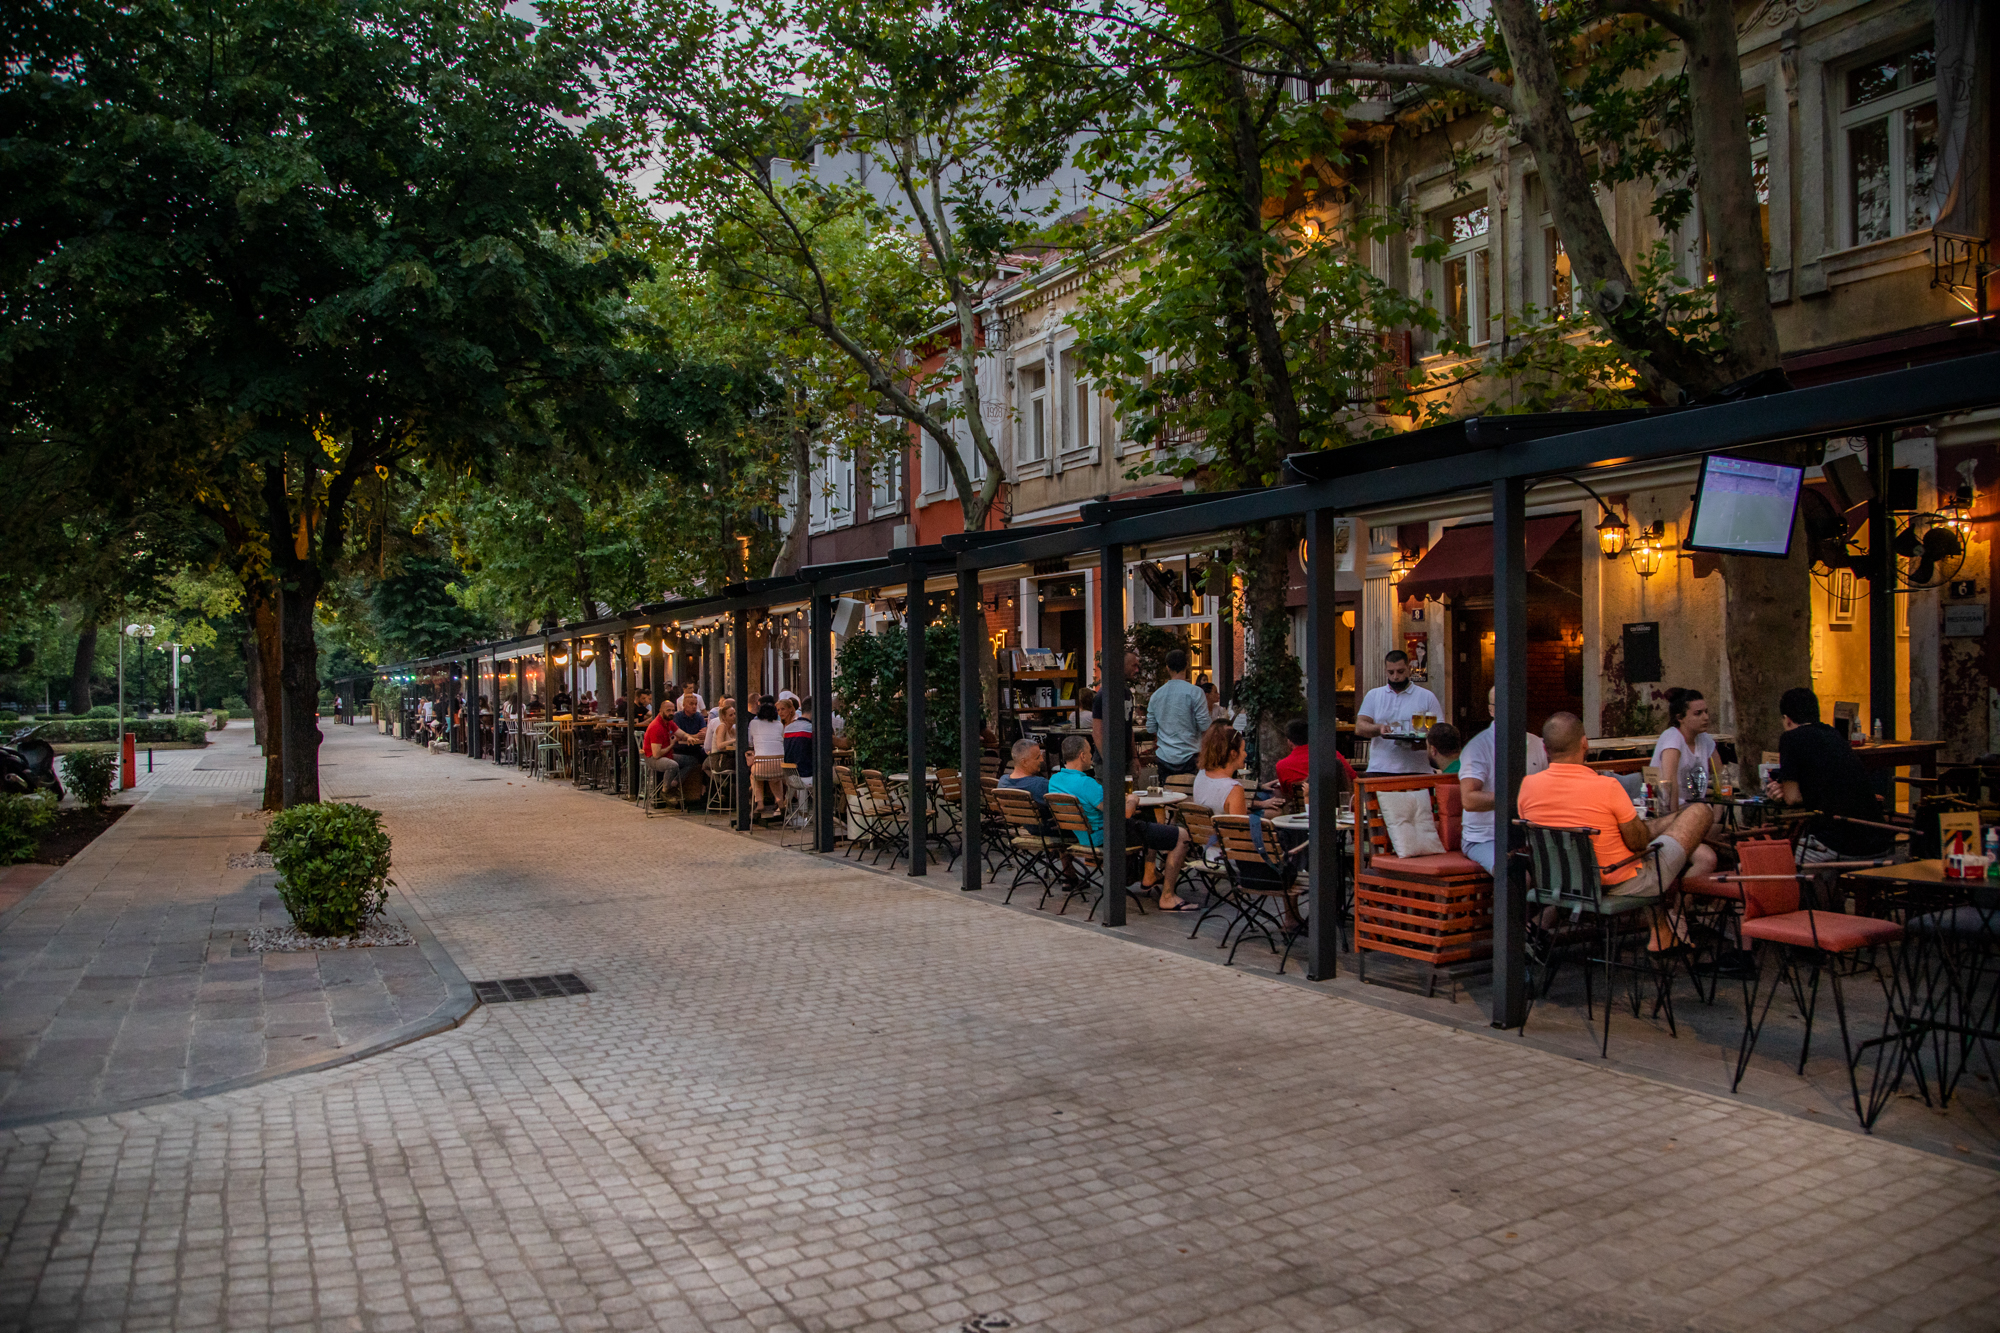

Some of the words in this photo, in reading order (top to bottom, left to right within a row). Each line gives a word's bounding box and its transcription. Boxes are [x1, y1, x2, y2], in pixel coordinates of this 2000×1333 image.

[987, 407, 1003, 418] 1928
[1958, 581, 1968, 596] 6
[1414, 609, 1420, 620] 8
